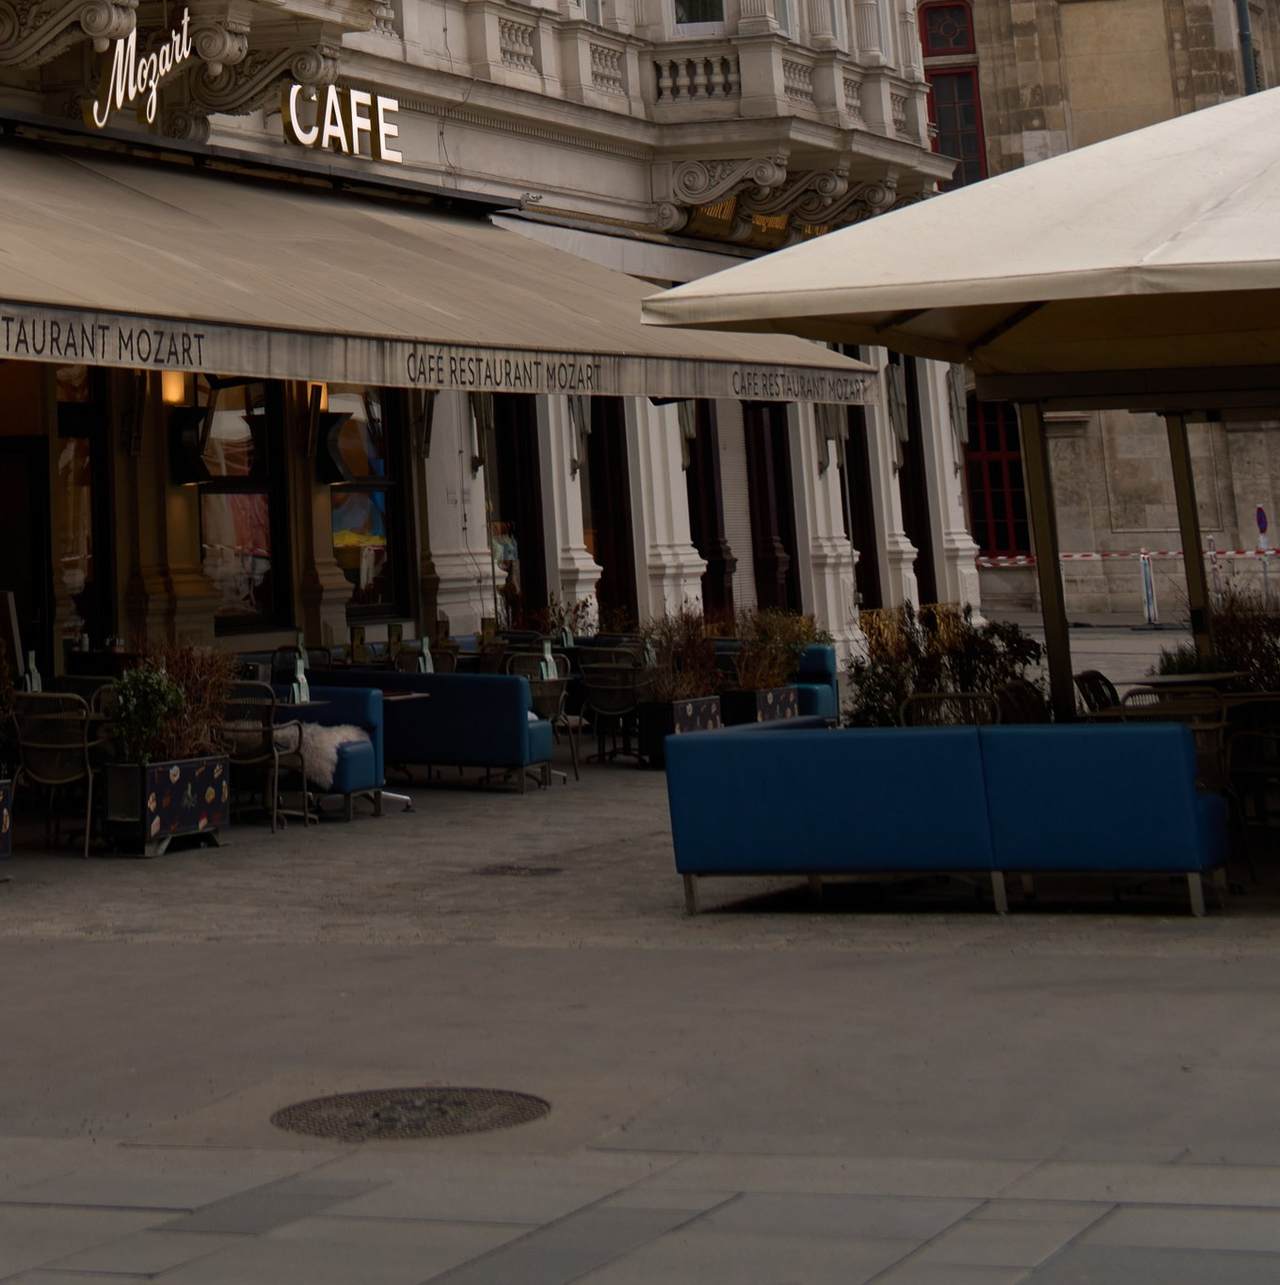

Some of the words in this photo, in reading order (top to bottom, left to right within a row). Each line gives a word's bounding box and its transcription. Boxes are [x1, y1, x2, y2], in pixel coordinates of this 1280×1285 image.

[93, 7, 192, 128] Mozart
[286, 84, 403, 164] CAFE
[118, 326, 205, 367] MOZART
[406, 348, 444, 385] CAFÉ
[449, 356, 542, 390] RESTAURANT
[545, 361, 602, 391] MOZART
[761, 372, 826, 400] RESTAURANT
[828, 377, 866, 401] MOZART
